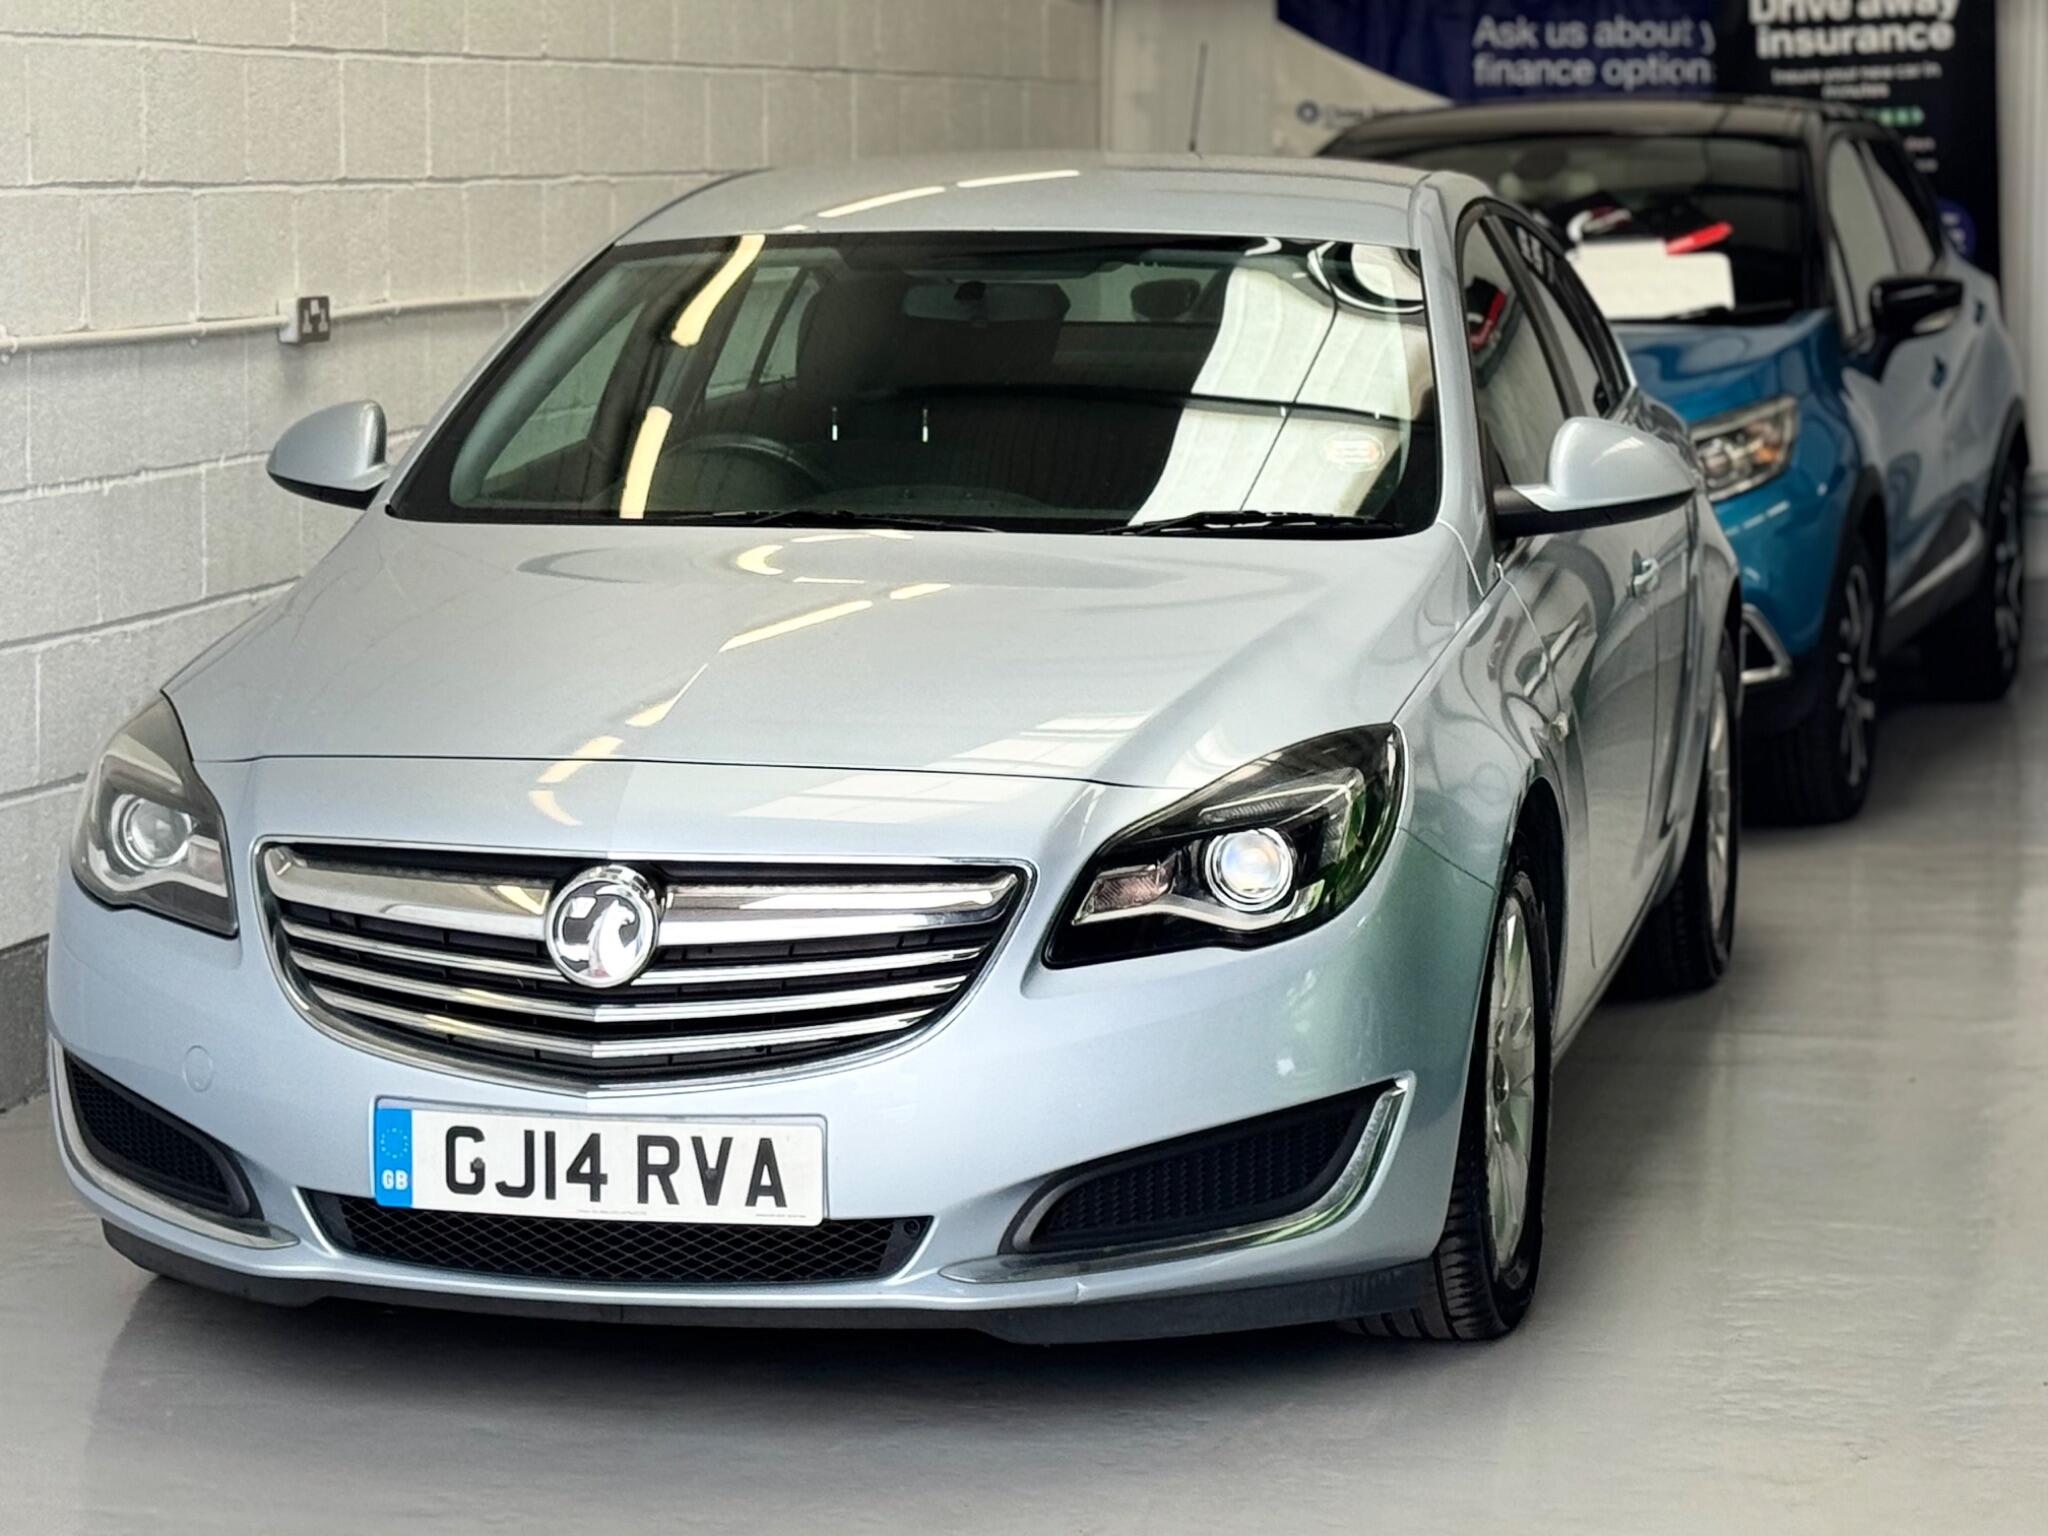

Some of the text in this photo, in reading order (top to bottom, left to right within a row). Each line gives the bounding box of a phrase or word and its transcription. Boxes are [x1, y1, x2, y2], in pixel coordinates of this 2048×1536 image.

[1749, 0, 1959, 24] Drive away
[1472, 14, 1540, 48] Ask
[1545, 20, 1588, 48] us
[1593, 14, 1695, 48] about
[1756, 21, 1956, 59] insurance
[1472, 51, 1716, 92] finance option
[382, 1168, 408, 1190] GB
[445, 1125, 788, 1208] GJ14 RVA
